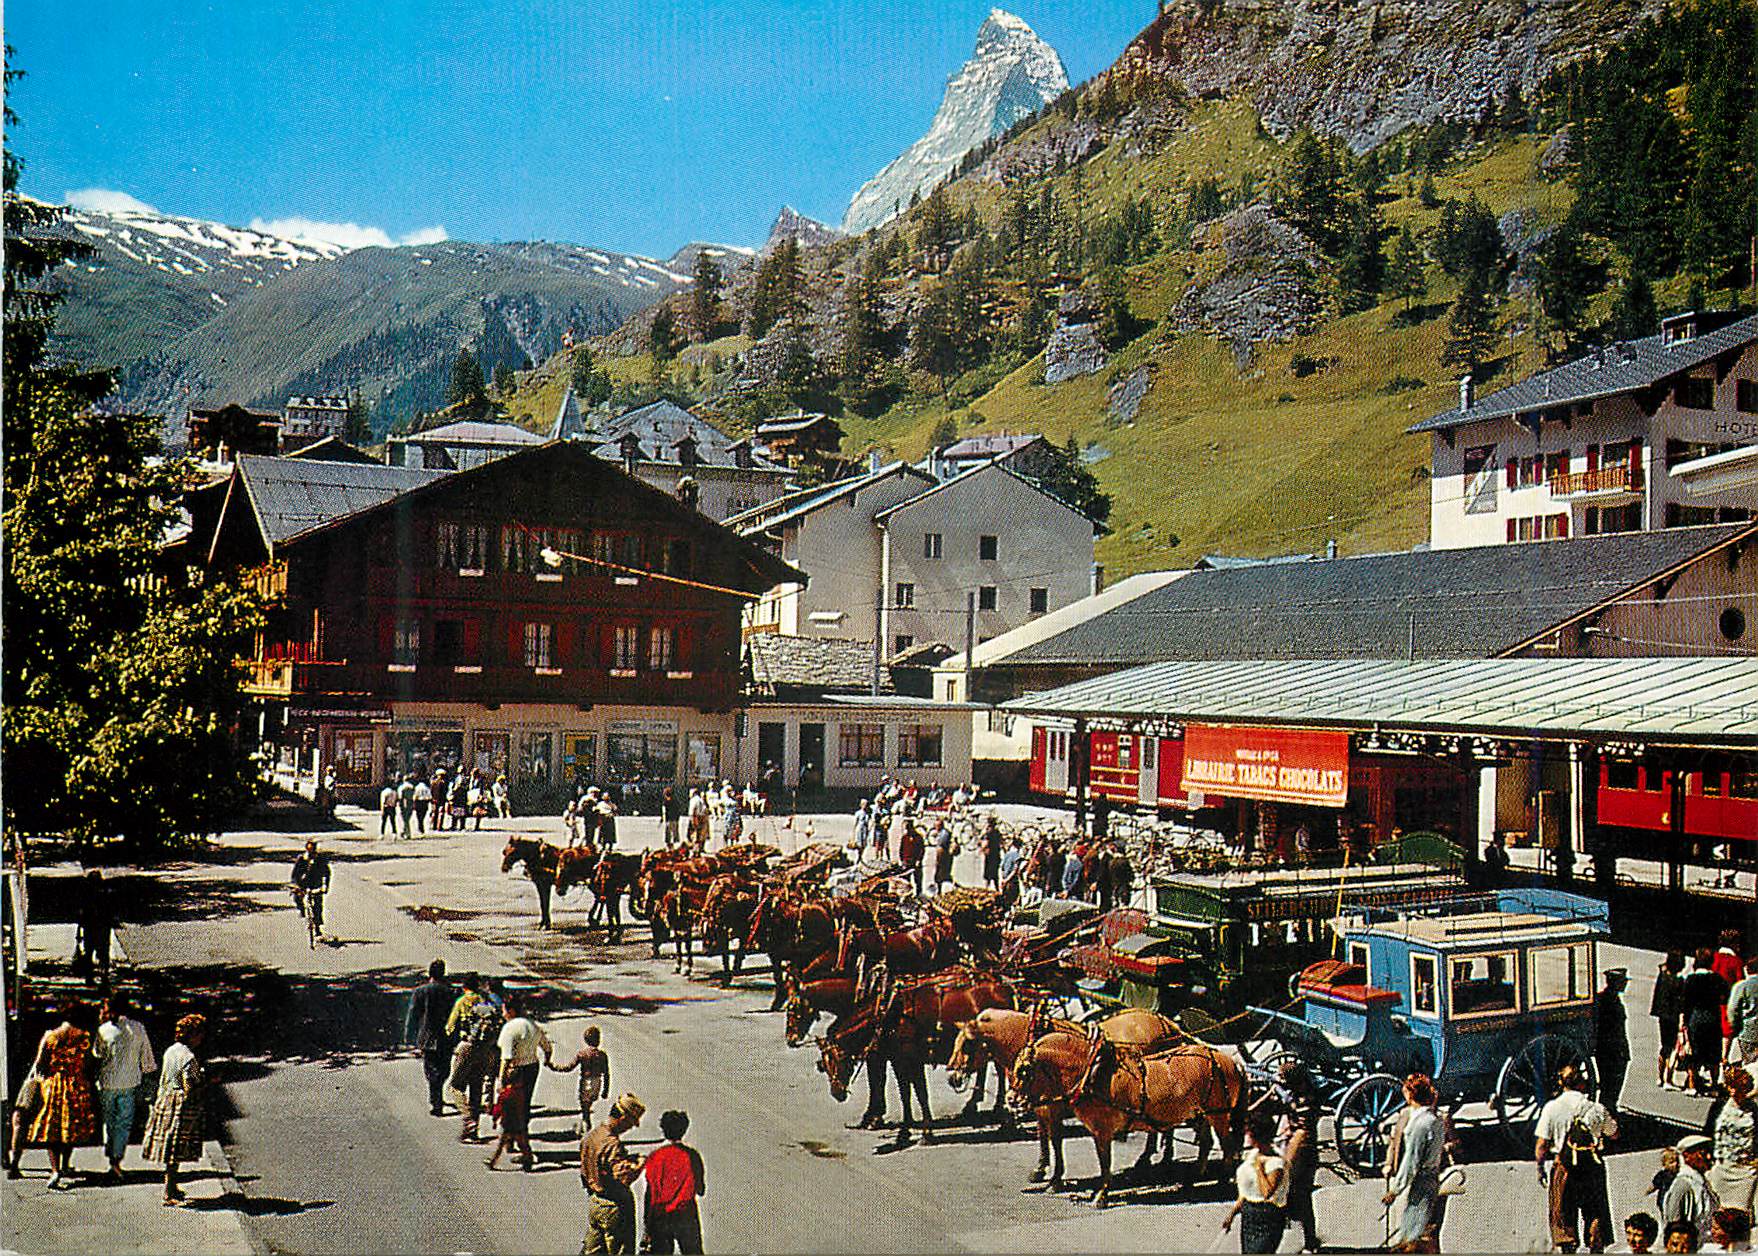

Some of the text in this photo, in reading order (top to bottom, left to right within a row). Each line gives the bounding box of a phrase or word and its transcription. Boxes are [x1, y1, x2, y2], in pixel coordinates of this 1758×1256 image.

[1186, 758, 1343, 791] LIBRAIRIE TABACS CHOCOLATS
